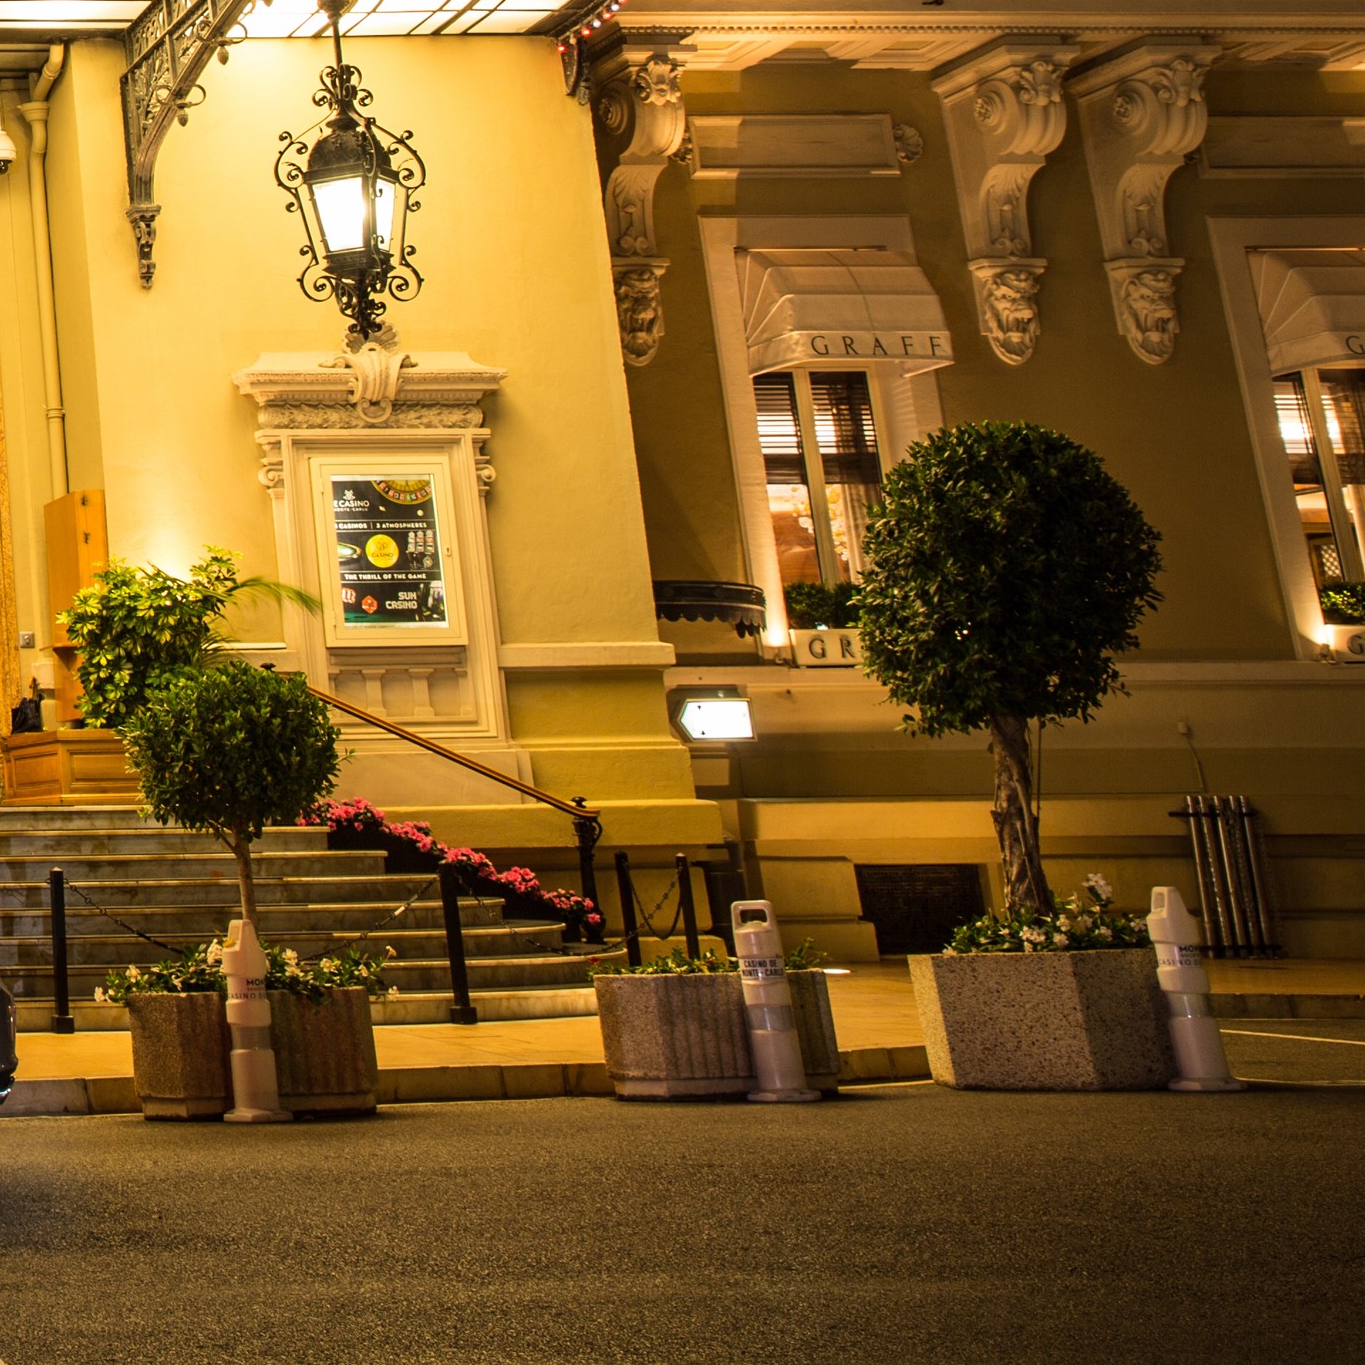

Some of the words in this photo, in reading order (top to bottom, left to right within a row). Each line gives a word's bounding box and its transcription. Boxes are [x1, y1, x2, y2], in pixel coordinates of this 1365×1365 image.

[811, 336, 941, 356] GRAFF
[399, 592, 417, 600] SUN
[386, 601, 417, 609] CASINO
